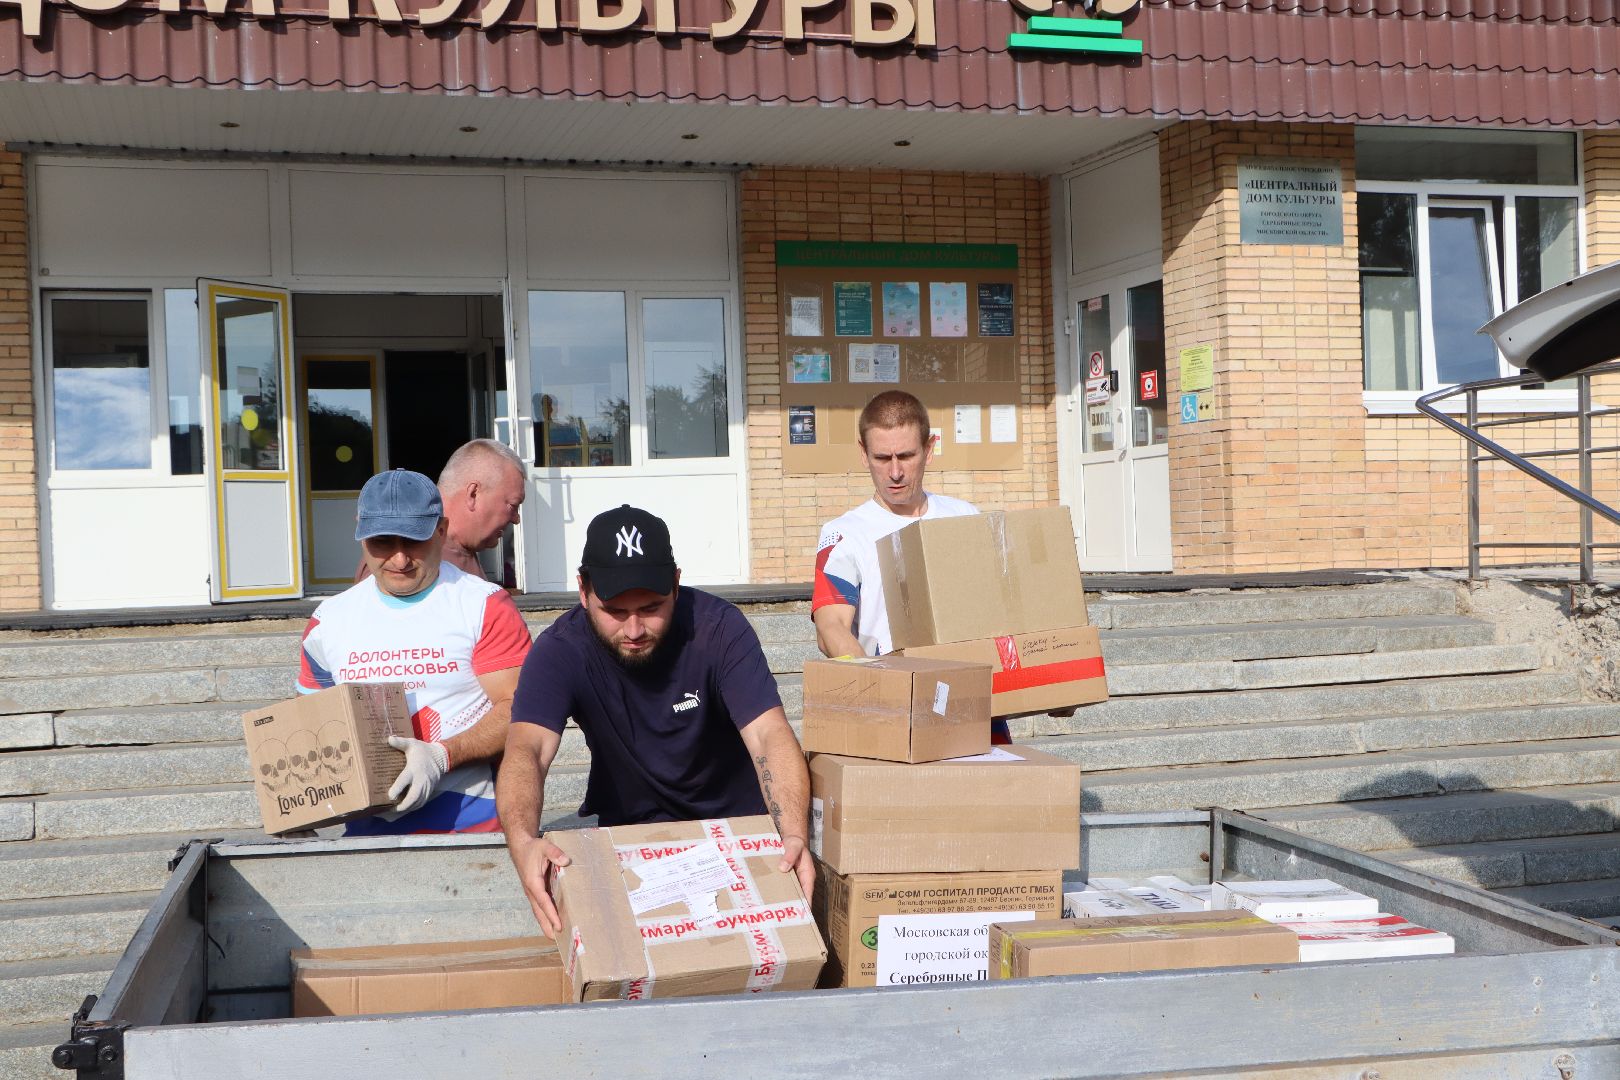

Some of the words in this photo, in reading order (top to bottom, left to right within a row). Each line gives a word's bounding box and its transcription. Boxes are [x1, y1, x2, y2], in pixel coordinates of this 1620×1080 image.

[1246, 193, 1272, 204] ДОМ
[1276, 194, 1336, 205] КУЛЬТУРЫ
[902, 249, 930, 262] ДОМ
[616, 525, 644, 558] NY
[348, 648, 445, 665] ВОЛОНТЕРЫ
[340, 661, 459, 681] ПОДМОСКОВЬЯ
[672, 699, 699, 713] PUMA
[865, 891, 884, 899] SFM
[898, 890, 921, 899] СФМ
[923, 887, 974, 898] ГОСПИТАЛ
[976, 886, 1027, 896] ПРОДАКТС
[1029, 885, 1055, 894] ГМБХ
[893, 926, 970, 938] Московская
[904, 947, 970, 964] городской
[889, 971, 973, 985] Серебряные
[977, 969, 988, 981] П
